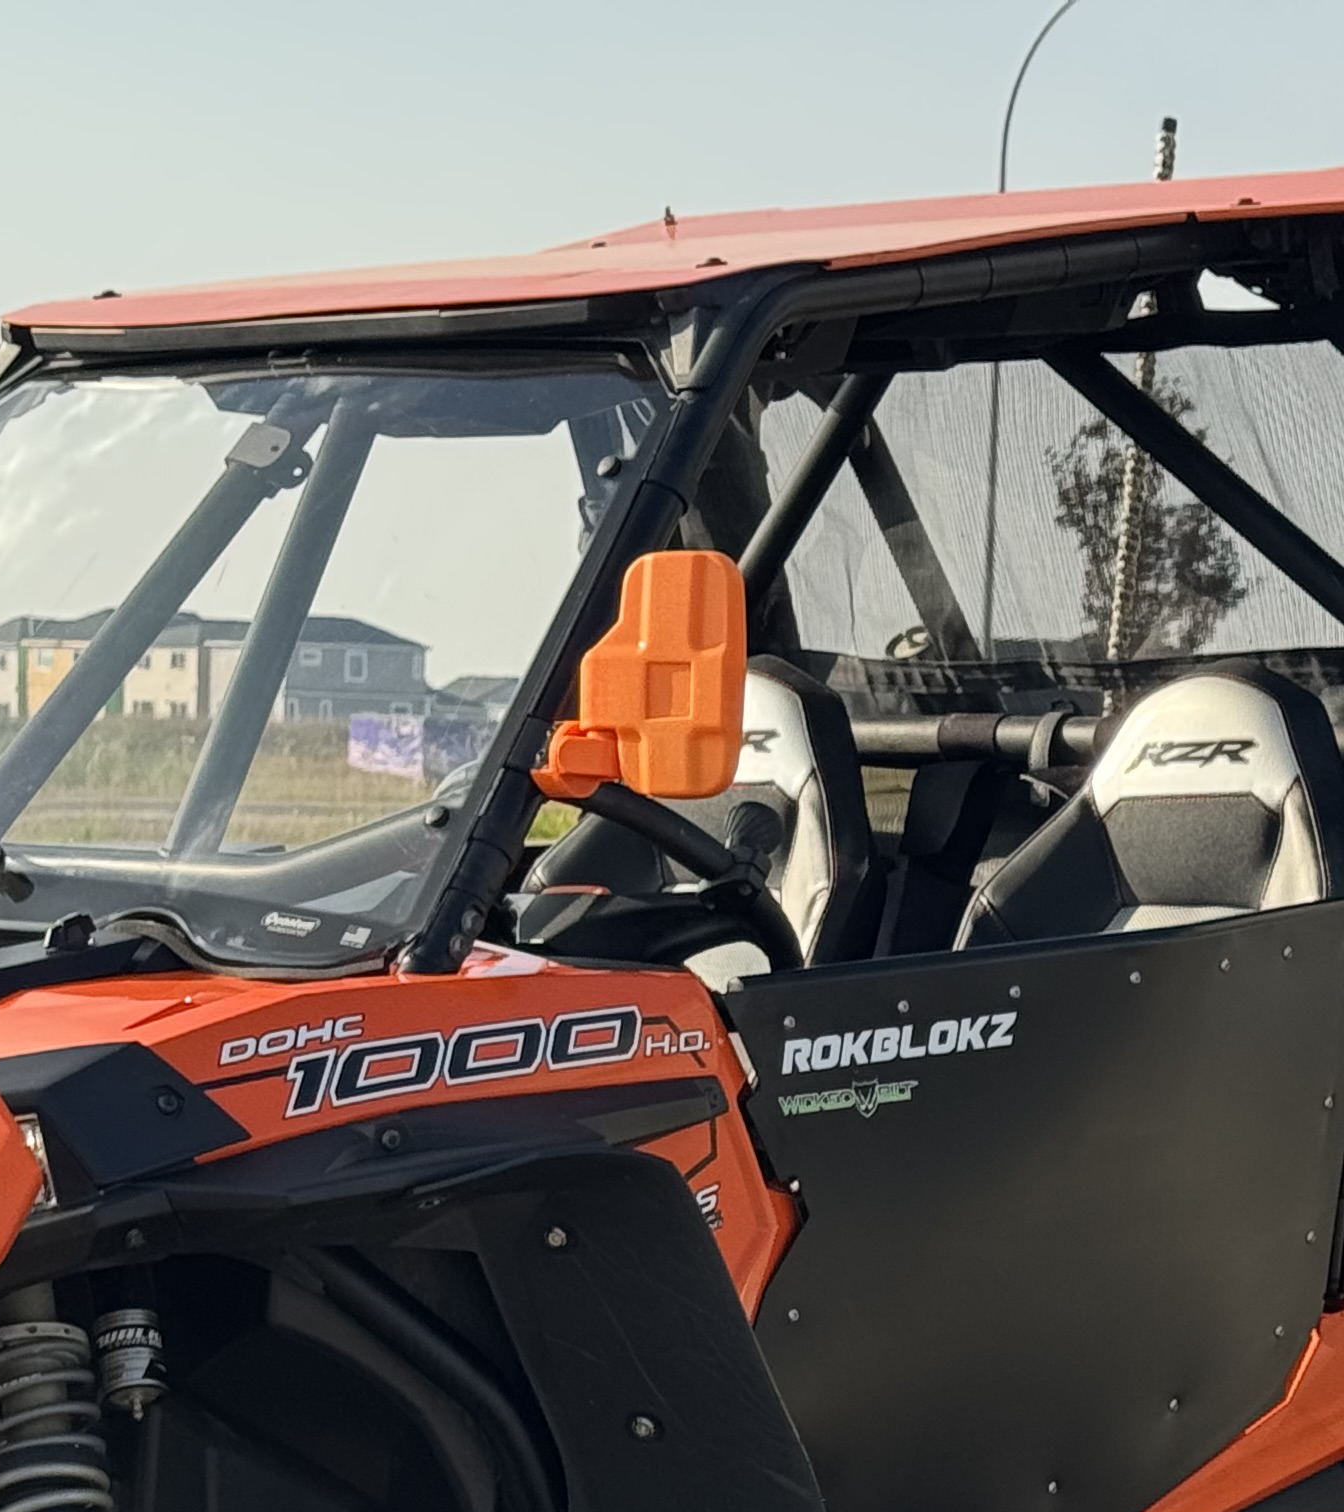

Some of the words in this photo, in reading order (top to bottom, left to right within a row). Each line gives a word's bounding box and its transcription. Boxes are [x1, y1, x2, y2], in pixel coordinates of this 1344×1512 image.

[219, 1013, 365, 1066] DOHC
[282, 1003, 642, 1119] 1000
[644, 1030, 711, 1058] H.O.
[781, 1011, 1018, 1075] ROKBLOKZ
